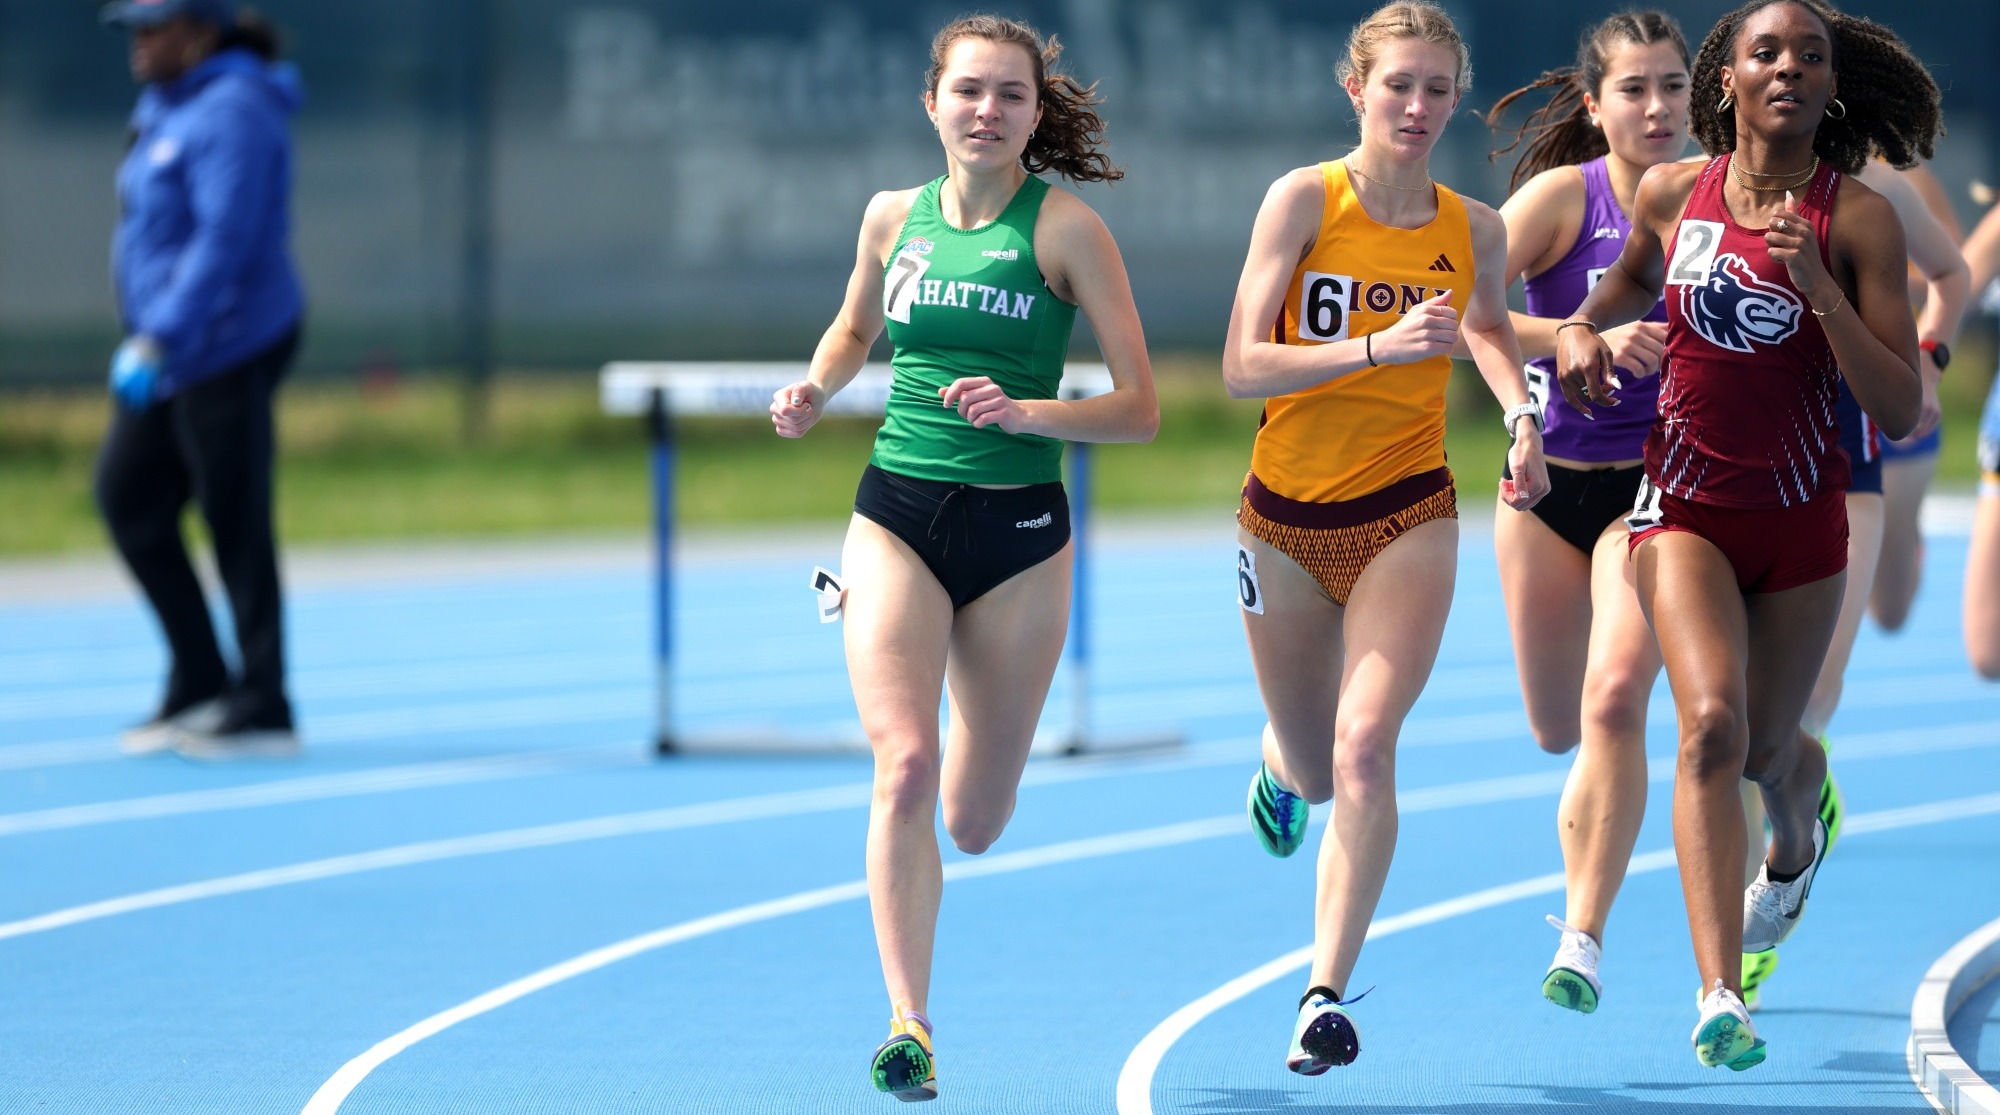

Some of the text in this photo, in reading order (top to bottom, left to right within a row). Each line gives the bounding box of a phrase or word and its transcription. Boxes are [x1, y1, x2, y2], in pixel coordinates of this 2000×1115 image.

[981, 249, 1018, 258] capelli
[1672, 225, 1713, 281] 2
[888, 256, 919, 313] 7
[1307, 278, 1343, 337] 6
[1349, 281, 1452, 315] ION
[1016, 512, 1051, 528] capelli
[1238, 549, 1256, 607] 6
